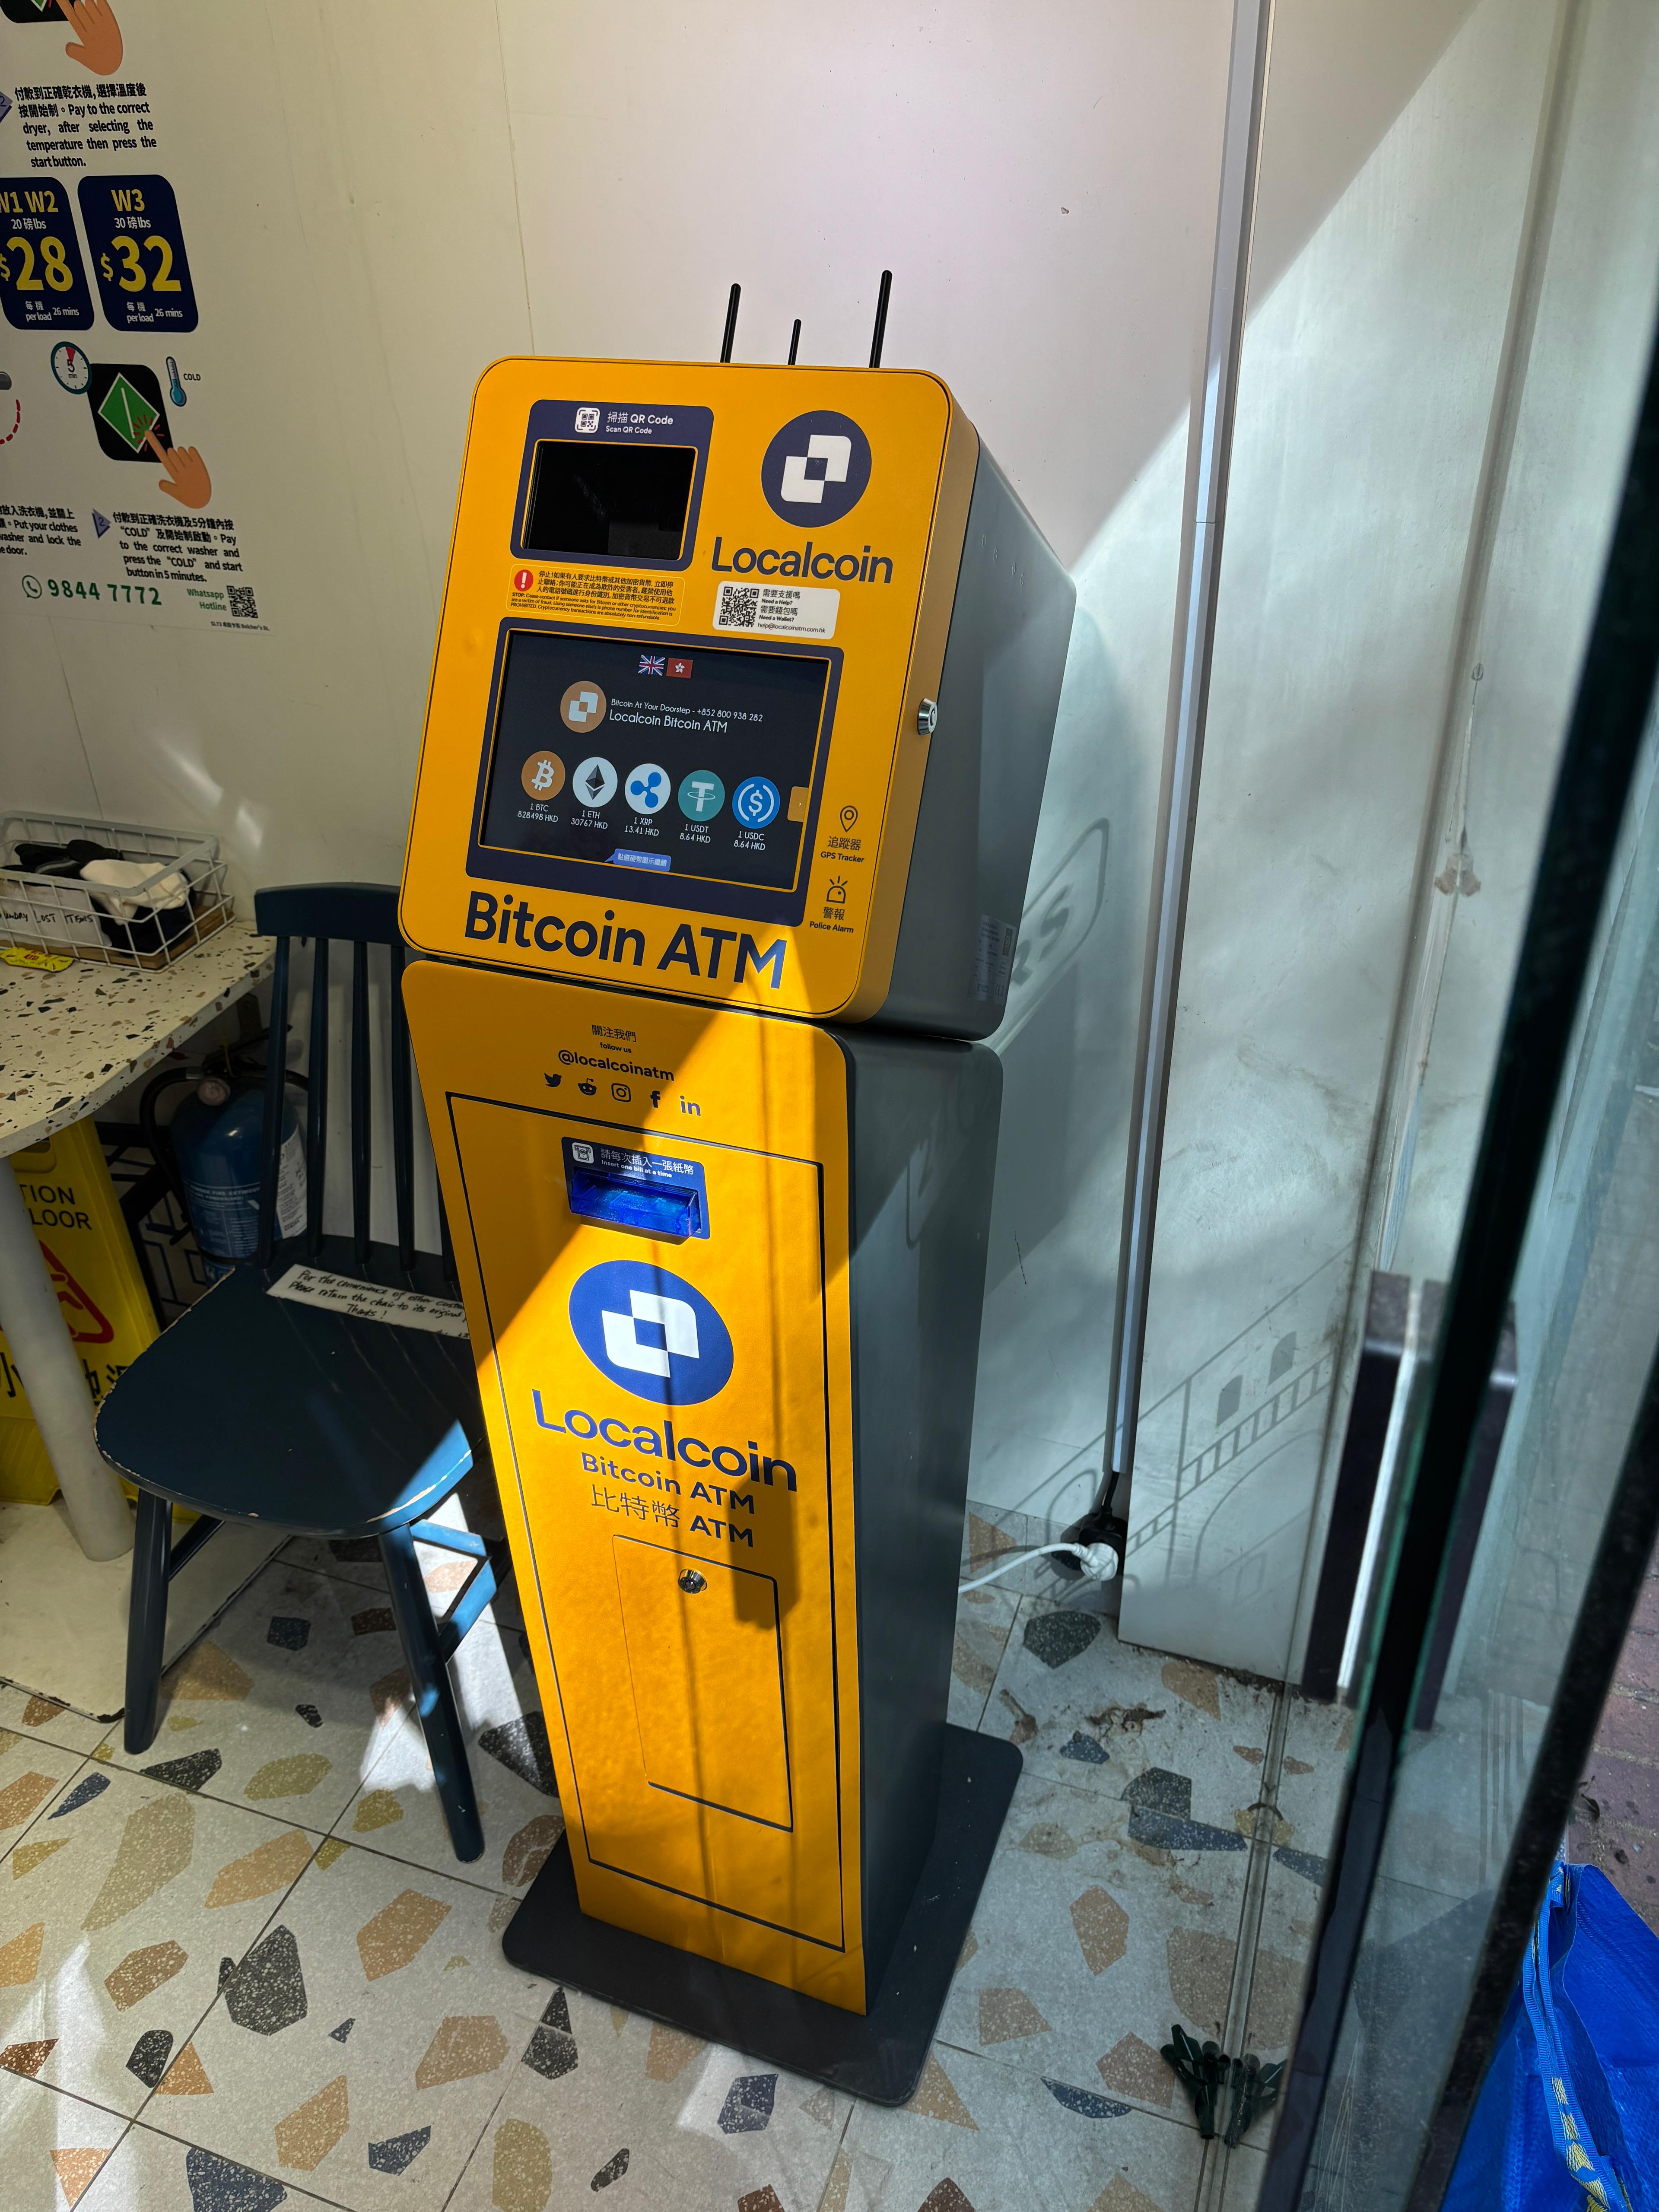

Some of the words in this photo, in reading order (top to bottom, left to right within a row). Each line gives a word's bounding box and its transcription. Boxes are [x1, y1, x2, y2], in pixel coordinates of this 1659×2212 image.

[68, 104, 85, 118] Pay
[87, 104, 98, 115] to
[99, 102, 115, 114] the
[117, 102, 150, 114] correct
[23, 122, 51, 136] dryer,
[58, 121, 79, 133] after
[89, 119, 130, 134] selecting
[137, 119, 153, 130] the
[26, 140, 83, 153] temperature
[86, 137, 108, 149] then
[112, 138, 137, 151] press
[140, 136, 157, 148] the
[31, 156, 52, 167] start
[52, 156, 86, 167] button.
[24, 191, 58, 213] W2
[111, 189, 145, 211] W3
[11, 219, 22, 229] 20
[114, 218, 126, 228] 30
[53, 307, 61, 315] 26
[63, 307, 79, 315] mins
[155, 308, 163, 317] 26
[165, 308, 183, 317] mins
[67, 359, 75, 372] 5
[607, 412, 628, 423] 掃描
[630, 414, 645, 424] QR
[648, 415, 673, 425] Code
[14, 520, 29, 529] Put
[29, 521, 47, 531] your
[49, 522, 78, 532] clothes
[28, 534, 44, 543] and
[46, 534, 64, 544] lock
[67, 537, 81, 546] the
[220, 534, 236, 546] Pay
[6, 545, 28, 555] door.
[119, 541, 129, 550] to
[133, 541, 148, 551] the
[153, 543, 182, 554] correct
[187, 546, 218, 556] washer
[223, 548, 240, 557] and
[123, 556, 145, 565] press
[146, 556, 161, 566] the
[204, 561, 220, 570] and
[222, 562, 243, 572] start
[711, 537, 893, 583] Localcoin
[126, 567, 154, 578] button
[155, 569, 163, 578] in
[164, 570, 169, 579] 5
[171, 572, 207, 582] minutes.
[48, 579, 101, 601] 9844
[107, 584, 162, 606] 7772
[187, 588, 224, 600] Whatsapp
[763, 589, 801, 600] 需要支援嗎
[199, 601, 227, 611] Hotline
[611, 699, 633, 709] Bitcoin
[644, 702, 658, 710] Your
[660, 704, 690, 715] Doorstep
[697, 709, 715, 717] +852
[717, 710, 731, 718] 800
[733, 712, 747, 720] 938
[749, 713, 763, 722] 282
[610, 709, 661, 726] Localcoin
[664, 715, 700, 731] Bitcoin
[703, 720, 728, 733] ATM
[536, 804, 549, 812] BTC
[588, 810, 600, 819] ETH
[518, 811, 543, 821] 828498
[640, 817, 653, 826] XRP
[571, 818, 593, 827] 30767
[594, 821, 608, 829] HKD
[691, 824, 709, 834] USDT
[624, 825, 643, 834] 13.41
[645, 828, 659, 836] HKD
[744, 832, 765, 842] USDC
[680, 833, 695, 842] 8.64
[696, 835, 711, 843] HKD
[734, 840, 749, 849] 8.64
[751, 842, 766, 851] HKD
[820, 851, 836, 859] GPS
[838, 853, 864, 863] Tracker
[33, 910, 56, 923] LOST
[823, 906, 845, 921] 警報
[810, 921, 831, 930] Police
[832, 925, 854, 933] Alarm
[464, 890, 645, 966] Bitcoin
[657, 923, 787, 989] ATM
[591, 1024, 636, 1042] 關注我們
[600, 1042, 622, 1052] follow
[558, 1049, 674, 1081] @localcoinatm
[601, 1148, 694, 1176] 請每次插入一張紙幣
[19, 1184, 75, 1205] TION
[29, 1208, 92, 1230] LOOR
[299, 1269, 315, 1281] For
[318, 1274, 335, 1285] the
[393, 1291, 405, 1301] of
[408, 1295, 432, 1304] other
[352, 1294, 367, 1303] the
[370, 1298, 393, 1309] chair
[397, 1301, 408, 1310] to
[413, 1304, 426, 1313] its
[532, 1389, 797, 1492] Localcoin
[582, 1452, 681, 1495] Bitcoin
[690, 1481, 754, 1514] ATM
[591, 1484, 680, 1528] 比特幣
[690, 1515, 753, 1548] ATM
